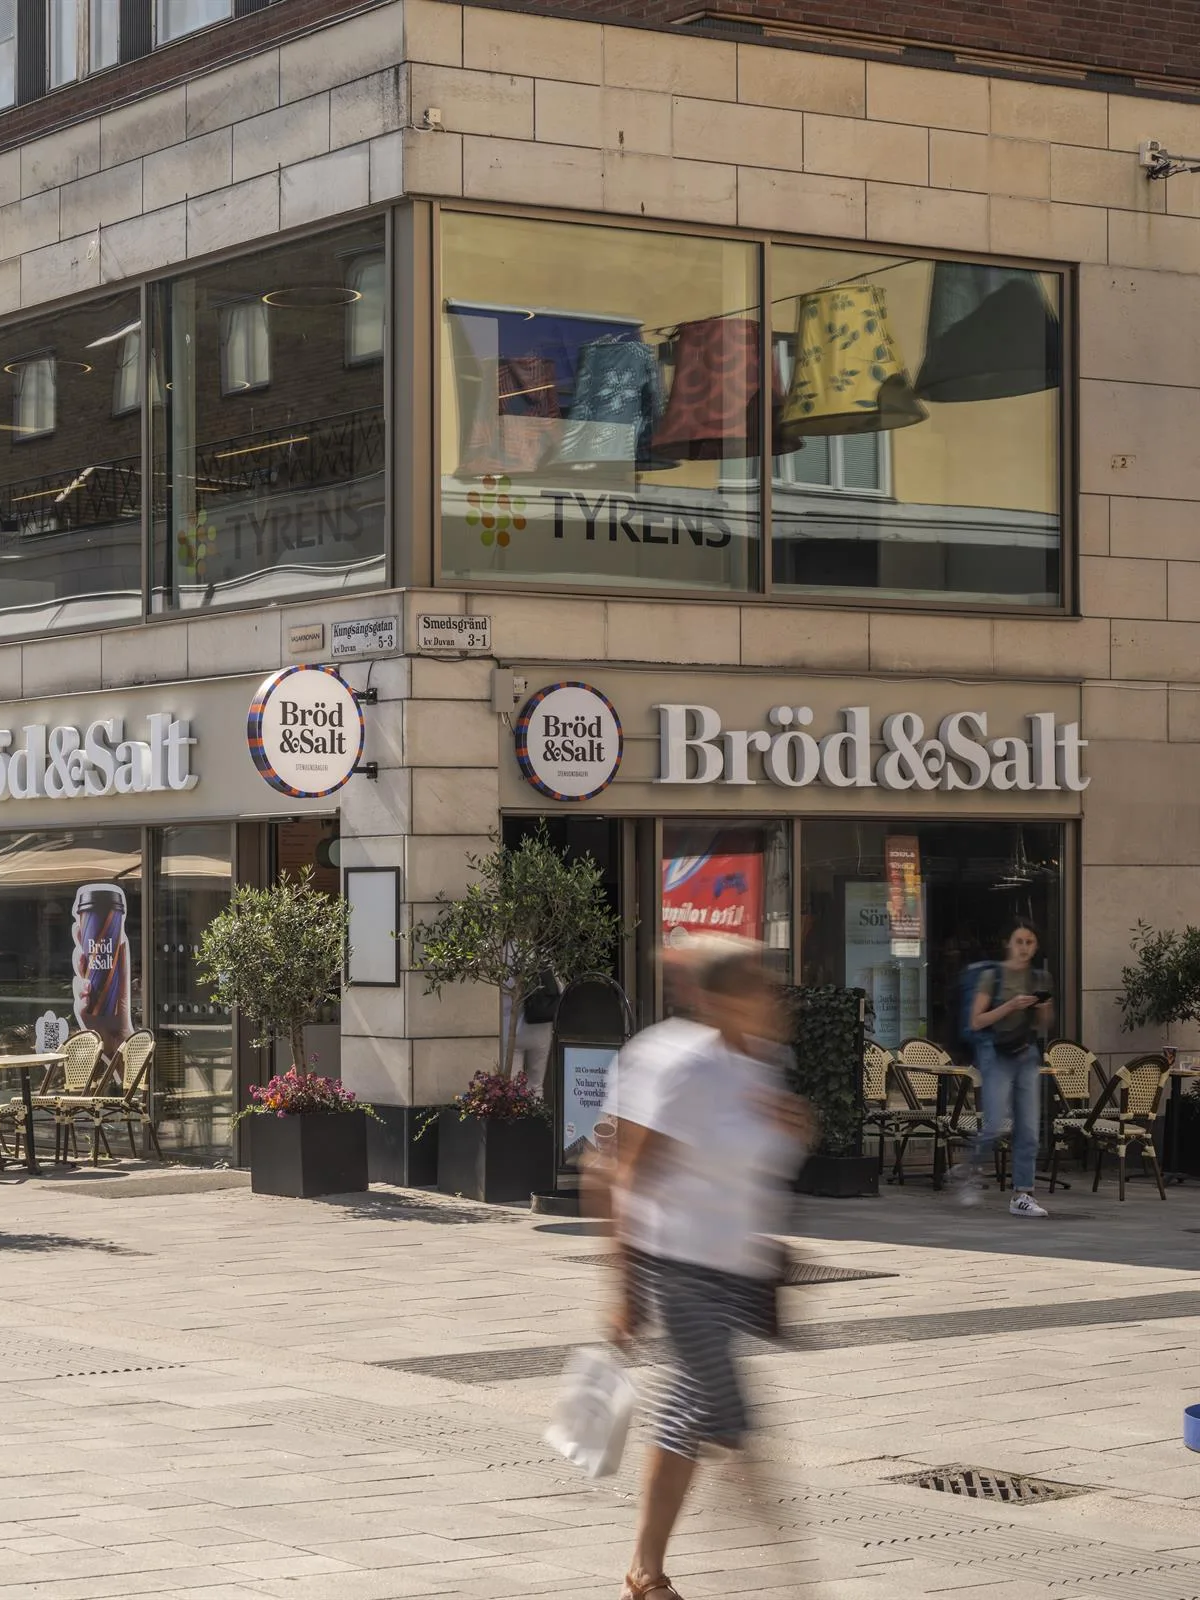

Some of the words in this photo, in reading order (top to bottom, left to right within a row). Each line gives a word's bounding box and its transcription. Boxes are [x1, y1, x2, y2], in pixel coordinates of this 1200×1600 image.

[225, 489, 363, 559] TYRENS
[540, 490, 731, 548] TYRENS
[333, 621, 393, 639] Kungsängsgatan
[423, 617, 487, 633] Smedsgränd
[341, 645, 356, 653] Duvan
[378, 635, 393, 649] 5-3
[433, 638, 455, 646] Duvan
[468, 634, 486, 647] 3-1
[280, 701, 344, 727] Bröd
[542, 715, 603, 738] Bröd
[280, 729, 347, 754] &Salt
[542, 739, 605, 762] &Salt
[652, 704, 1091, 791] Bröd&Salt
[88, 938, 113, 954] Bröd
[88, 955, 113, 970] &Salt
[573, 1088, 608, 1097] Co-workin
